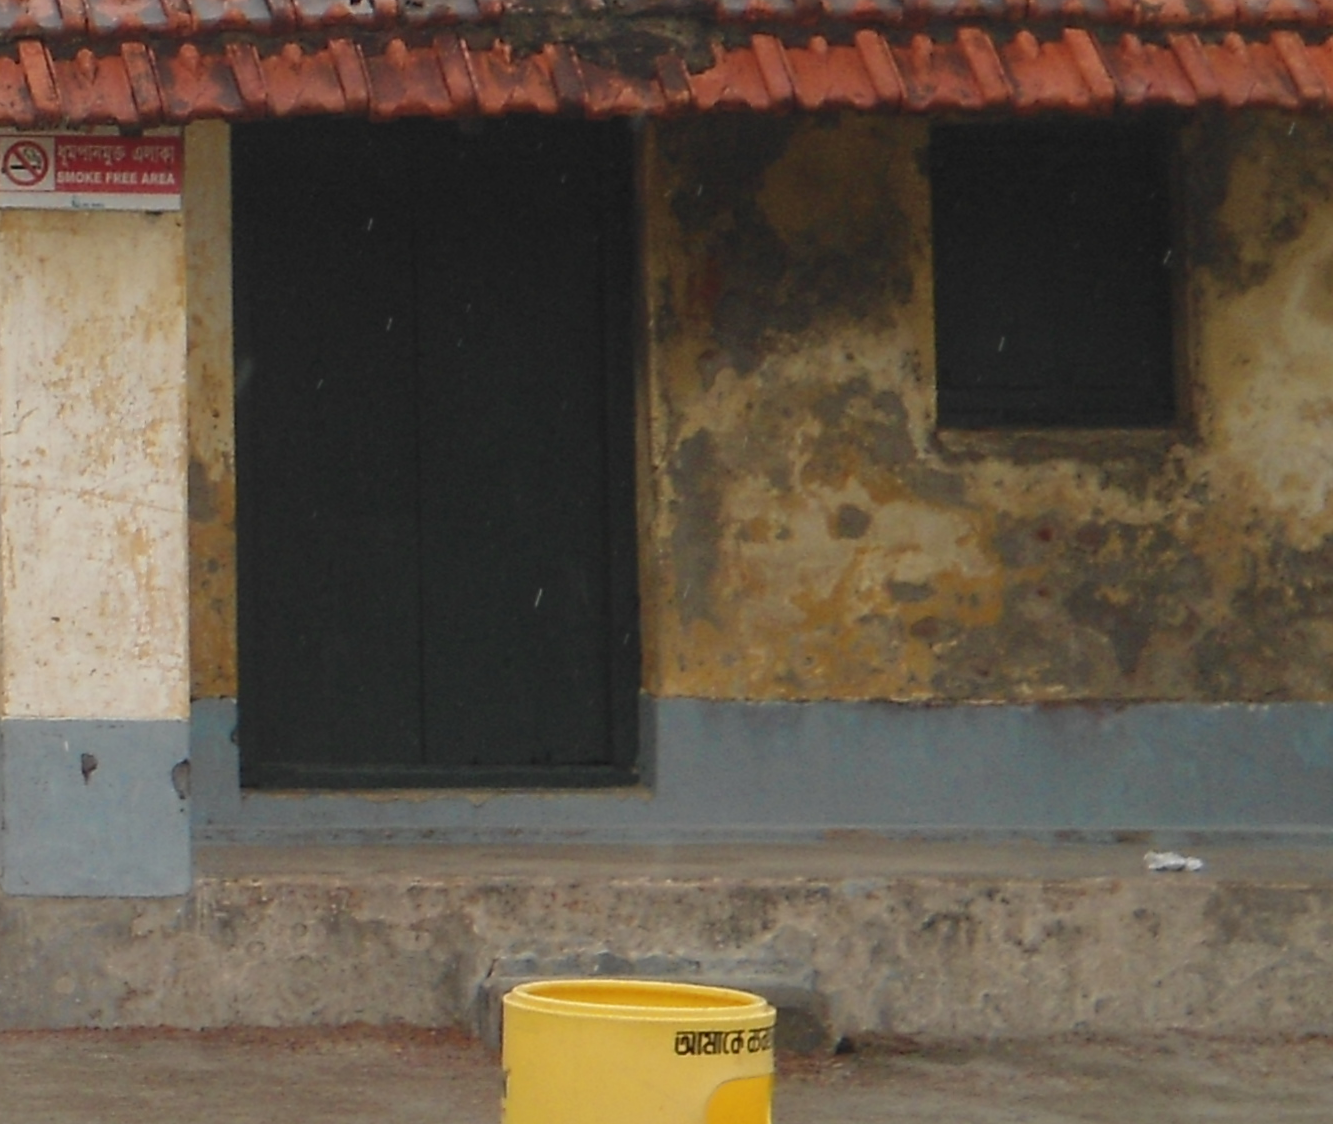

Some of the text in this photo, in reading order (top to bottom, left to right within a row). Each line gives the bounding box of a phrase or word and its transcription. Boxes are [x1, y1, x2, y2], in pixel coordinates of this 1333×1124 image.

[132, 144, 175, 165] এলাকা
[56, 171, 175, 185] SMOKE FREE AREA
[674, 1029, 745, 1056] আমাকে
